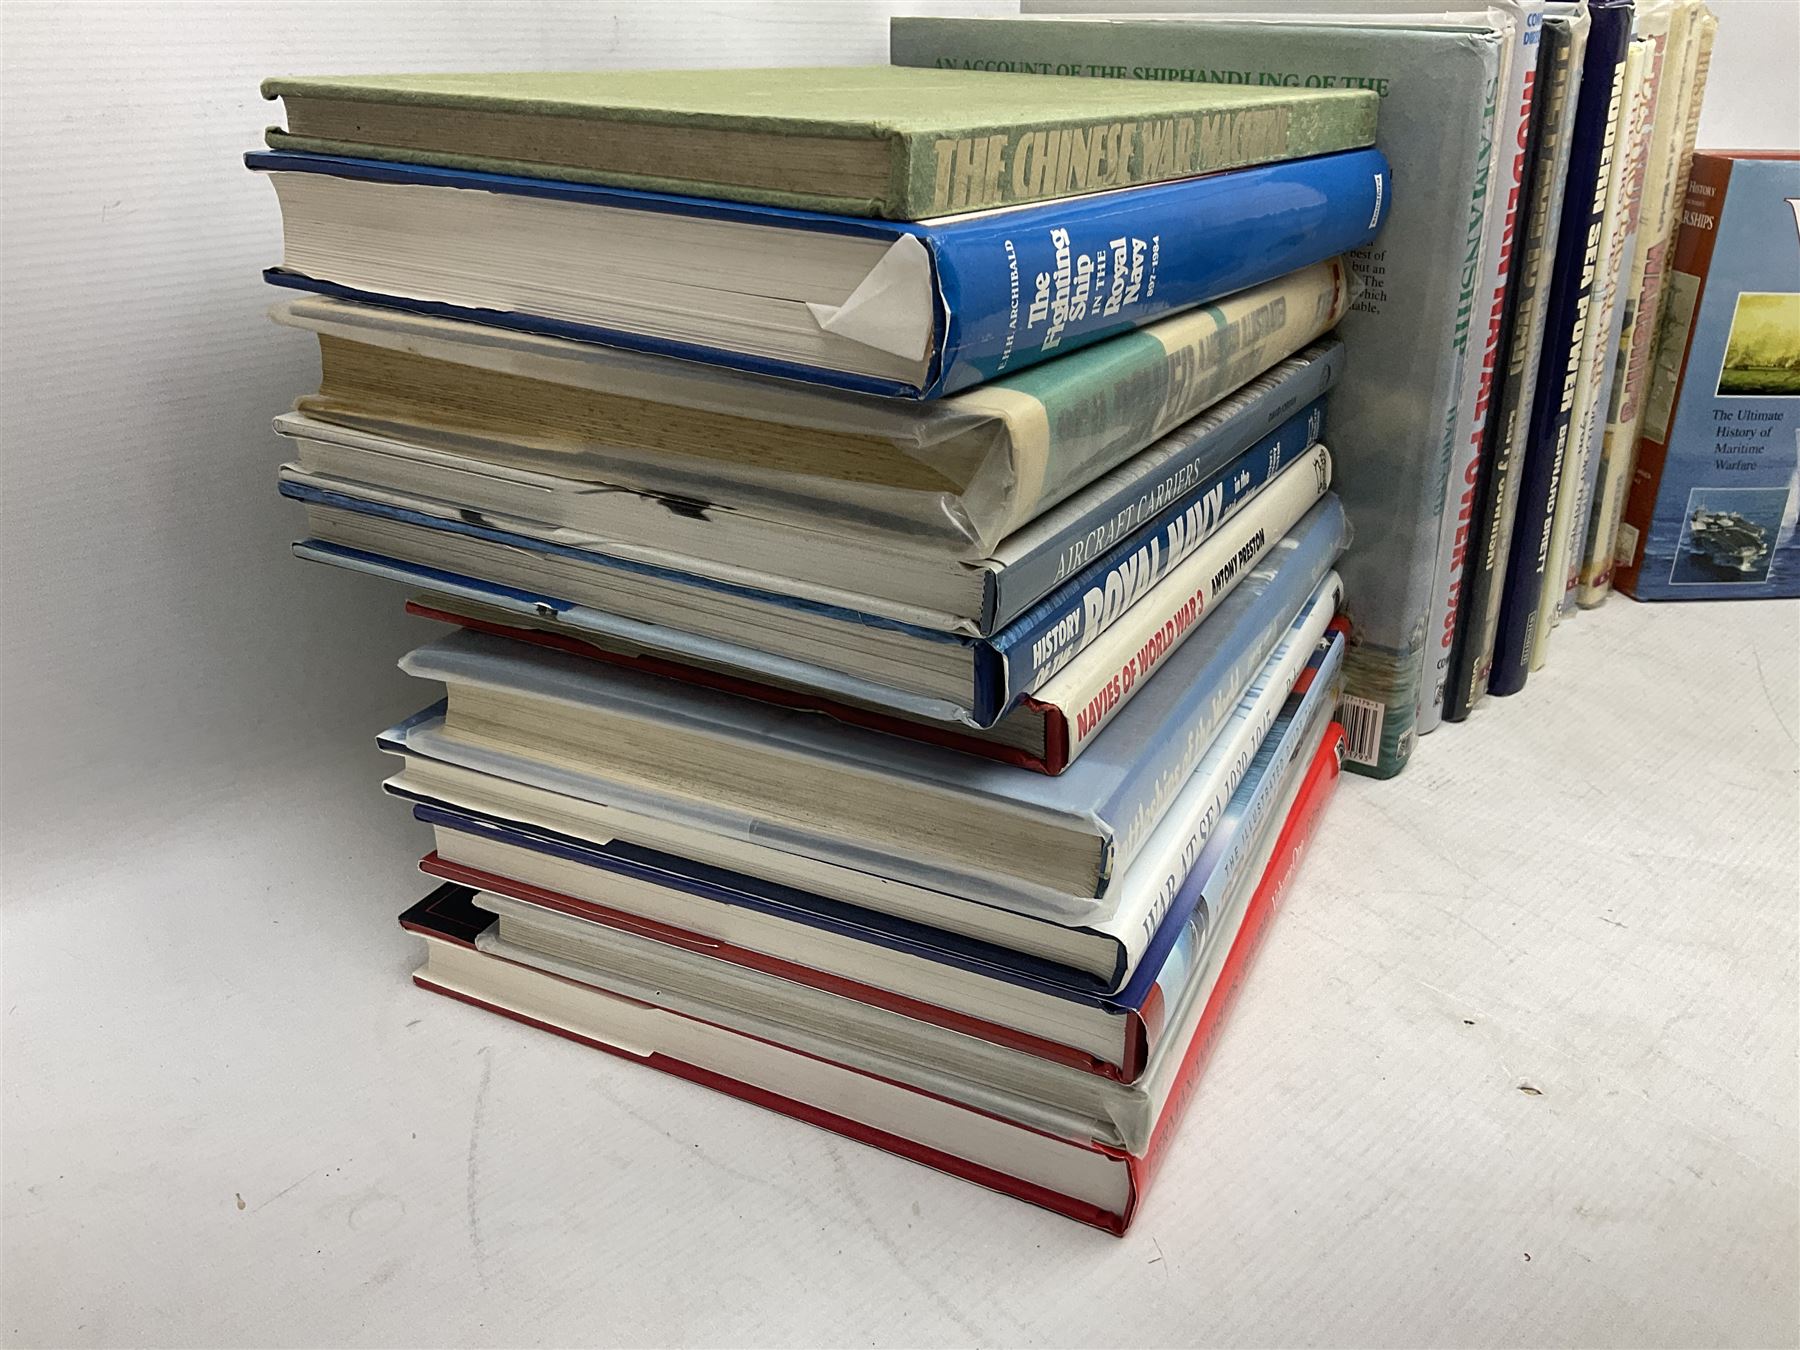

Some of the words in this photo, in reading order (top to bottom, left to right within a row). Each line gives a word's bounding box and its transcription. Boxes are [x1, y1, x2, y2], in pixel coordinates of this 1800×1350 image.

[1087, 65, 1127, 79] THE
[1133, 67, 1299, 87] SHIPHANDLING
[1341, 77, 1389, 97] THE
[933, 135, 1008, 210] THE
[1012, 122, 1137, 198] CHINESE
[1141, 117, 1196, 180] WAR
[1592, 61, 1627, 215] MODERN
[1682, 210, 1714, 231] RSHIPS
[1005, 239, 1019, 329] ARCHIBALD
[1041, 227, 1071, 352] Fighting
[1068, 254, 1095, 322] Ship
[1096, 250, 1106, 291] THE
[1103, 237, 1128, 317] Royal
[1123, 238, 1147, 306] Navy
[1352, 261, 1369, 272] but
[1373, 266, 1385, 274] an
[1363, 275, 1384, 287] The
[1375, 250, 1388, 261] of
[1580, 221, 1602, 290] SEA
[1027, 271, 1050, 329] The
[1091, 295, 1103, 315] IN
[1560, 295, 1590, 413] POWER
[1713, 409, 1733, 421] The
[1737, 409, 1784, 421] Ultimate
[1714, 443, 1764, 454] Maritime
[1716, 426, 1757, 440] History
[1760, 426, 1773, 437] of
[1546, 424, 1567, 514] BERNARD
[1716, 459, 1757, 471] Warfare
[1053, 504, 1135, 584] AIRCRAFT
[1137, 458, 1200, 524] CARRIERS
[1450, 429, 1485, 573] POWER
[1078, 536, 1161, 651] ROYAL
[1162, 483, 1224, 579] NAVY
[1211, 556, 1238, 599] ANTONY
[1238, 528, 1265, 567] PRESTON
[1536, 516, 1553, 573] BRETT
[1032, 608, 1080, 670] HISTORY
[1076, 674, 1121, 742] NAVIES
[1122, 658, 1137, 694] OF
[1137, 620, 1174, 676] WORLD
[1173, 596, 1197, 638] WAR
[1196, 589, 1204, 615] 3
[1142, 874, 1176, 944] WAR
[1182, 834, 1198, 879] AT
[1199, 795, 1221, 842] SEA
